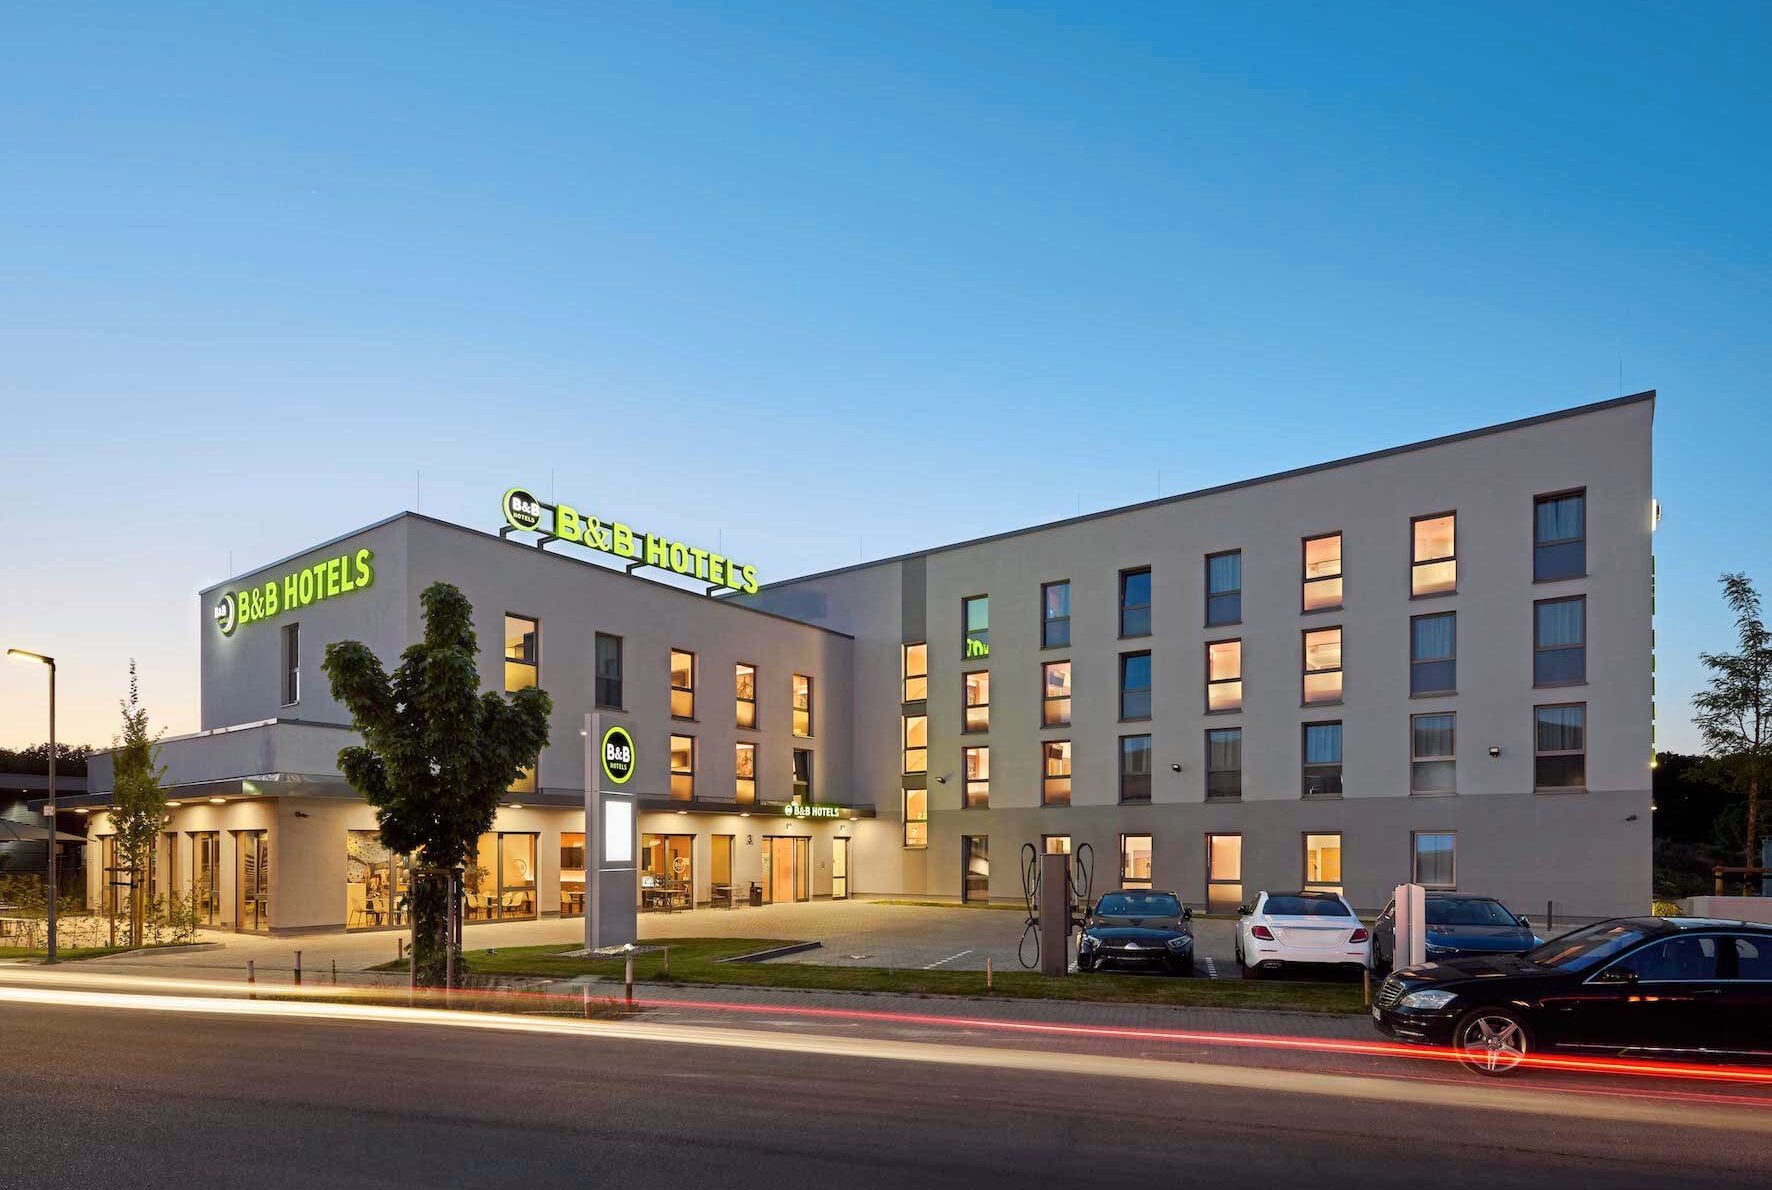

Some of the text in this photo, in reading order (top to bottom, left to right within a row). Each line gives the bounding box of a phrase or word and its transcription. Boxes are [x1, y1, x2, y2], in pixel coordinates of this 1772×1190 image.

[512, 496, 540, 517] B&B
[512, 511, 535, 524] HOTELS
[555, 504, 759, 594] B&B HOTELS
[238, 548, 371, 625] B&B HOTELS
[606, 743, 630, 763] B&B
[793, 805, 811, 816] B&B
[812, 806, 840, 818] HOTELS
